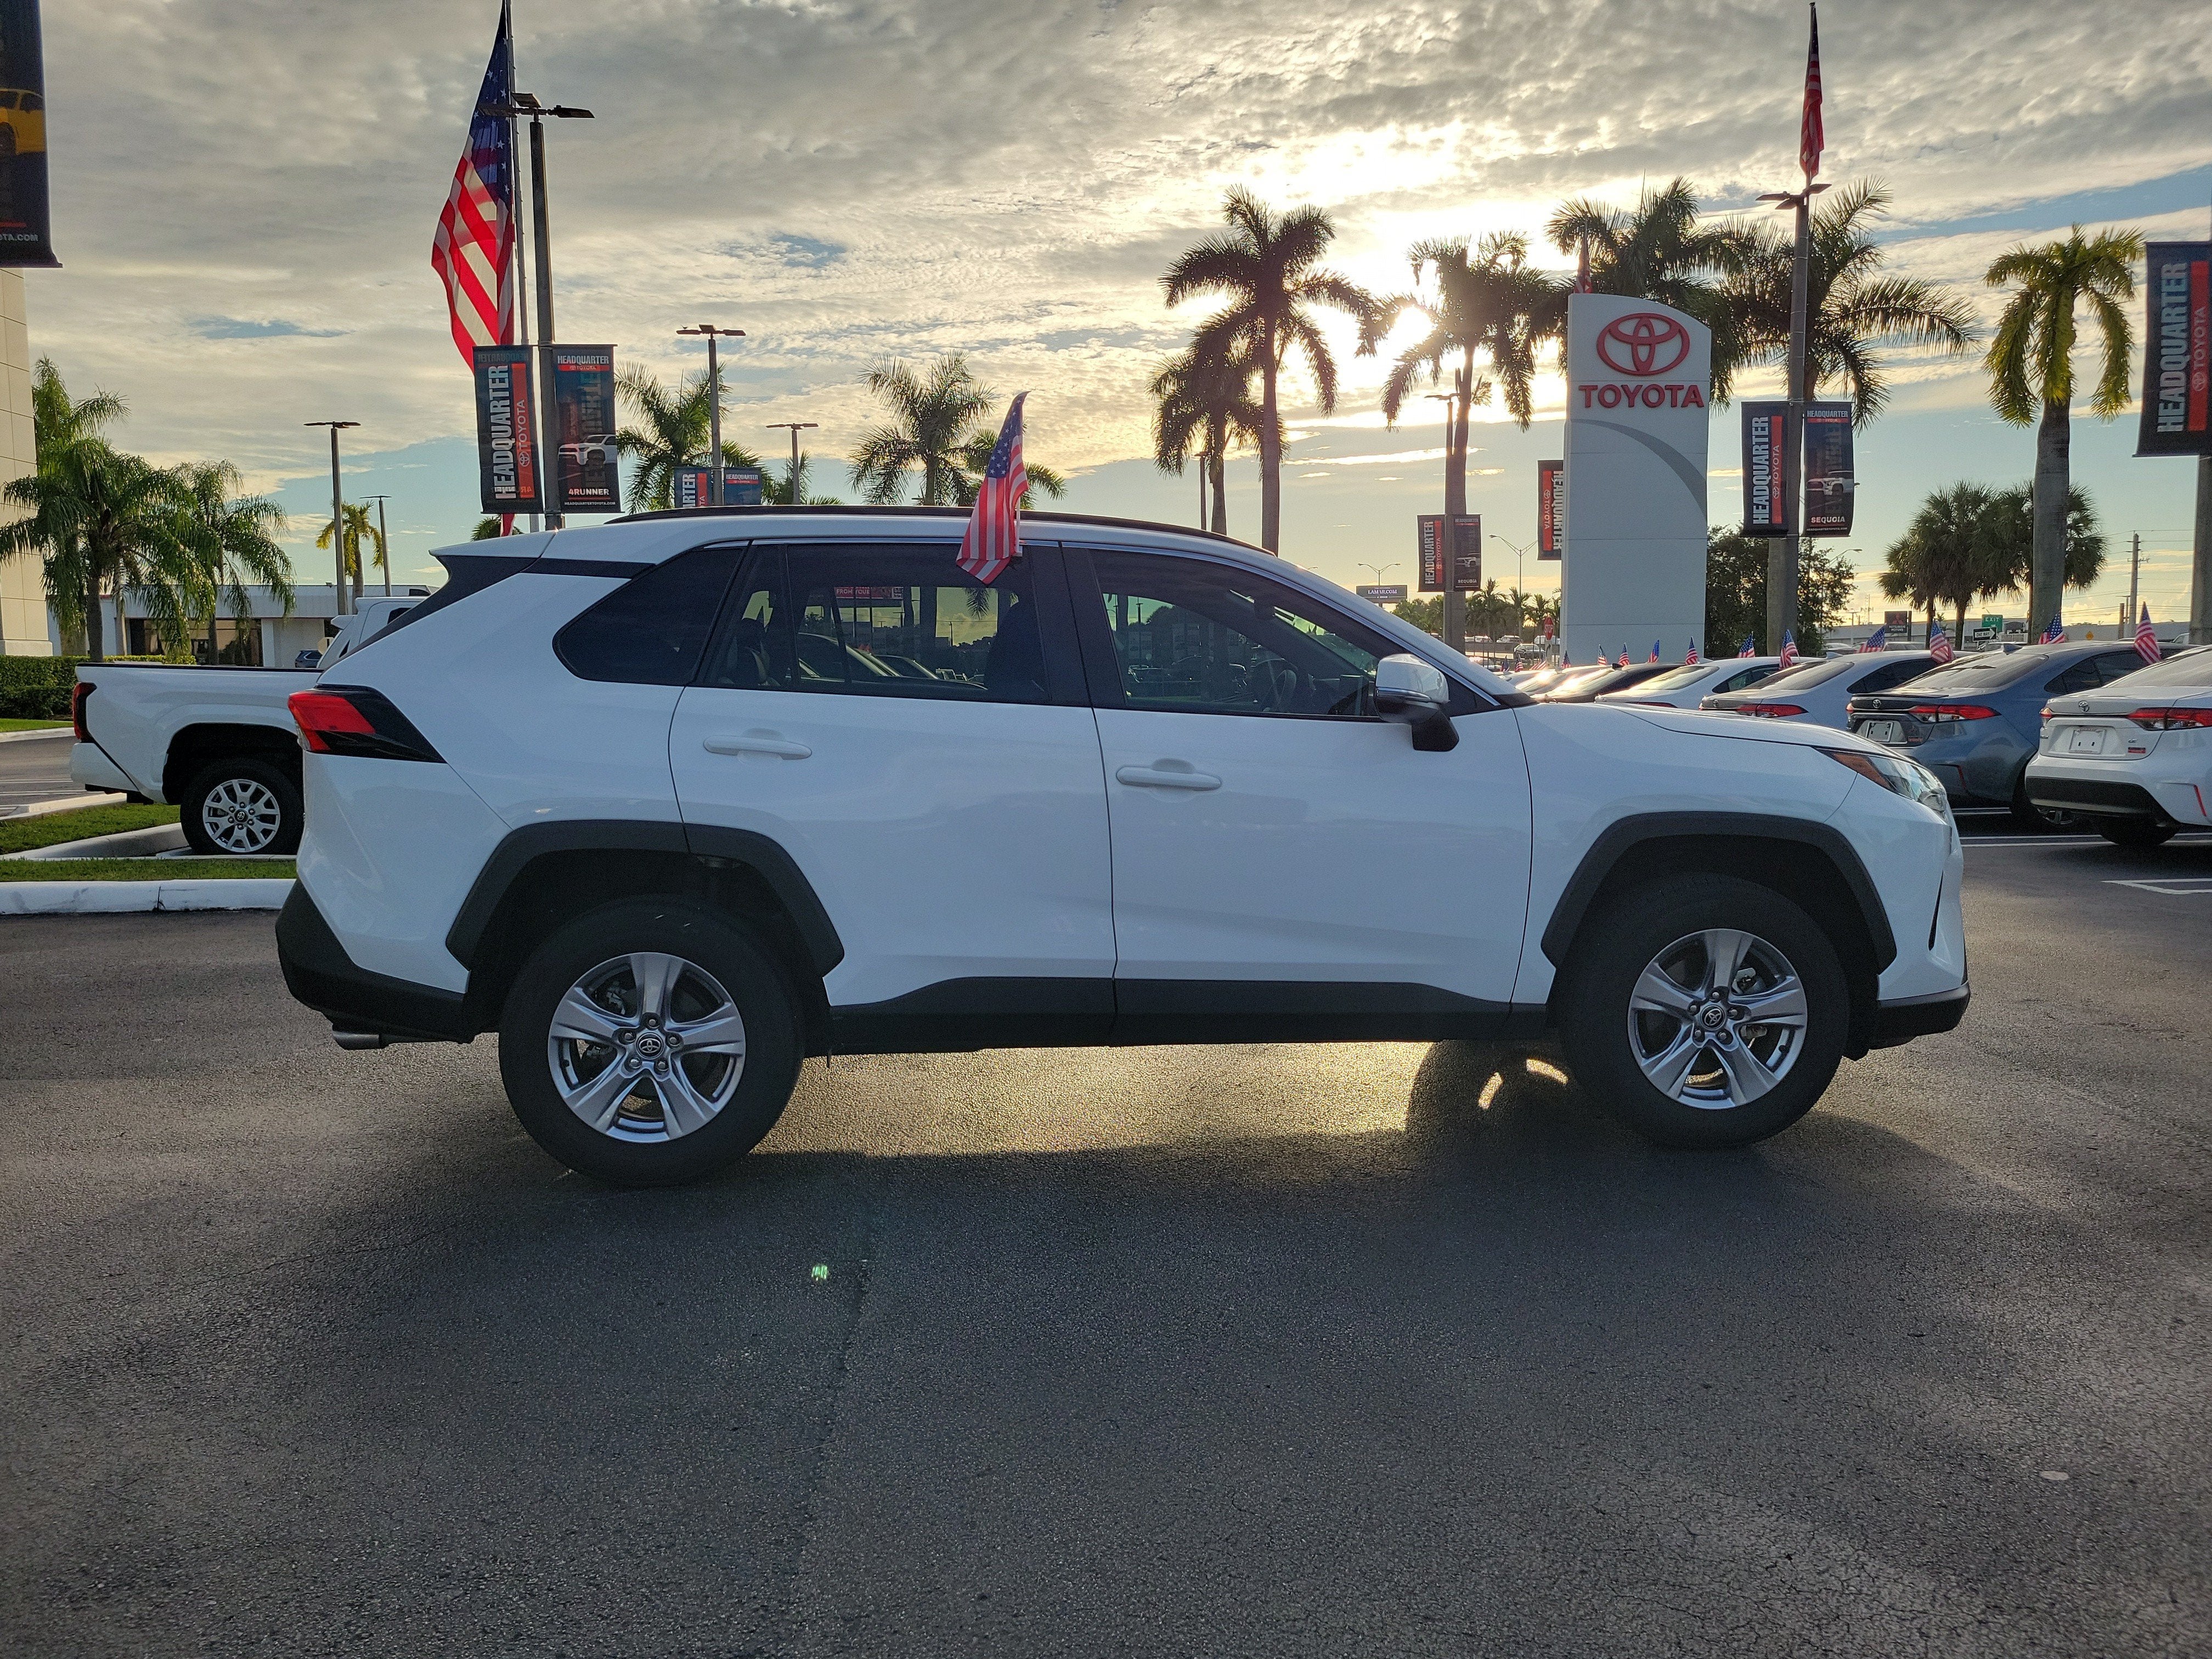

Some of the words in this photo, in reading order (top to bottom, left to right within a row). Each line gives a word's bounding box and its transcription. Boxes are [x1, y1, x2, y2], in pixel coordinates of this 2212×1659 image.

[557, 355, 609, 365] HEADQUARTER
[2157, 262, 2192, 432] HEADQUARTER
[2193, 306, 2207, 371] TOYOTA
[517, 399, 527, 449] TOYOTA
[1578, 384, 1704, 408] TOYOTA
[488, 365, 516, 499] HEADQUARTER
[1752, 416, 1771, 524] HEADQUARTER
[1424, 522, 1435, 584] HEADQUARTER
